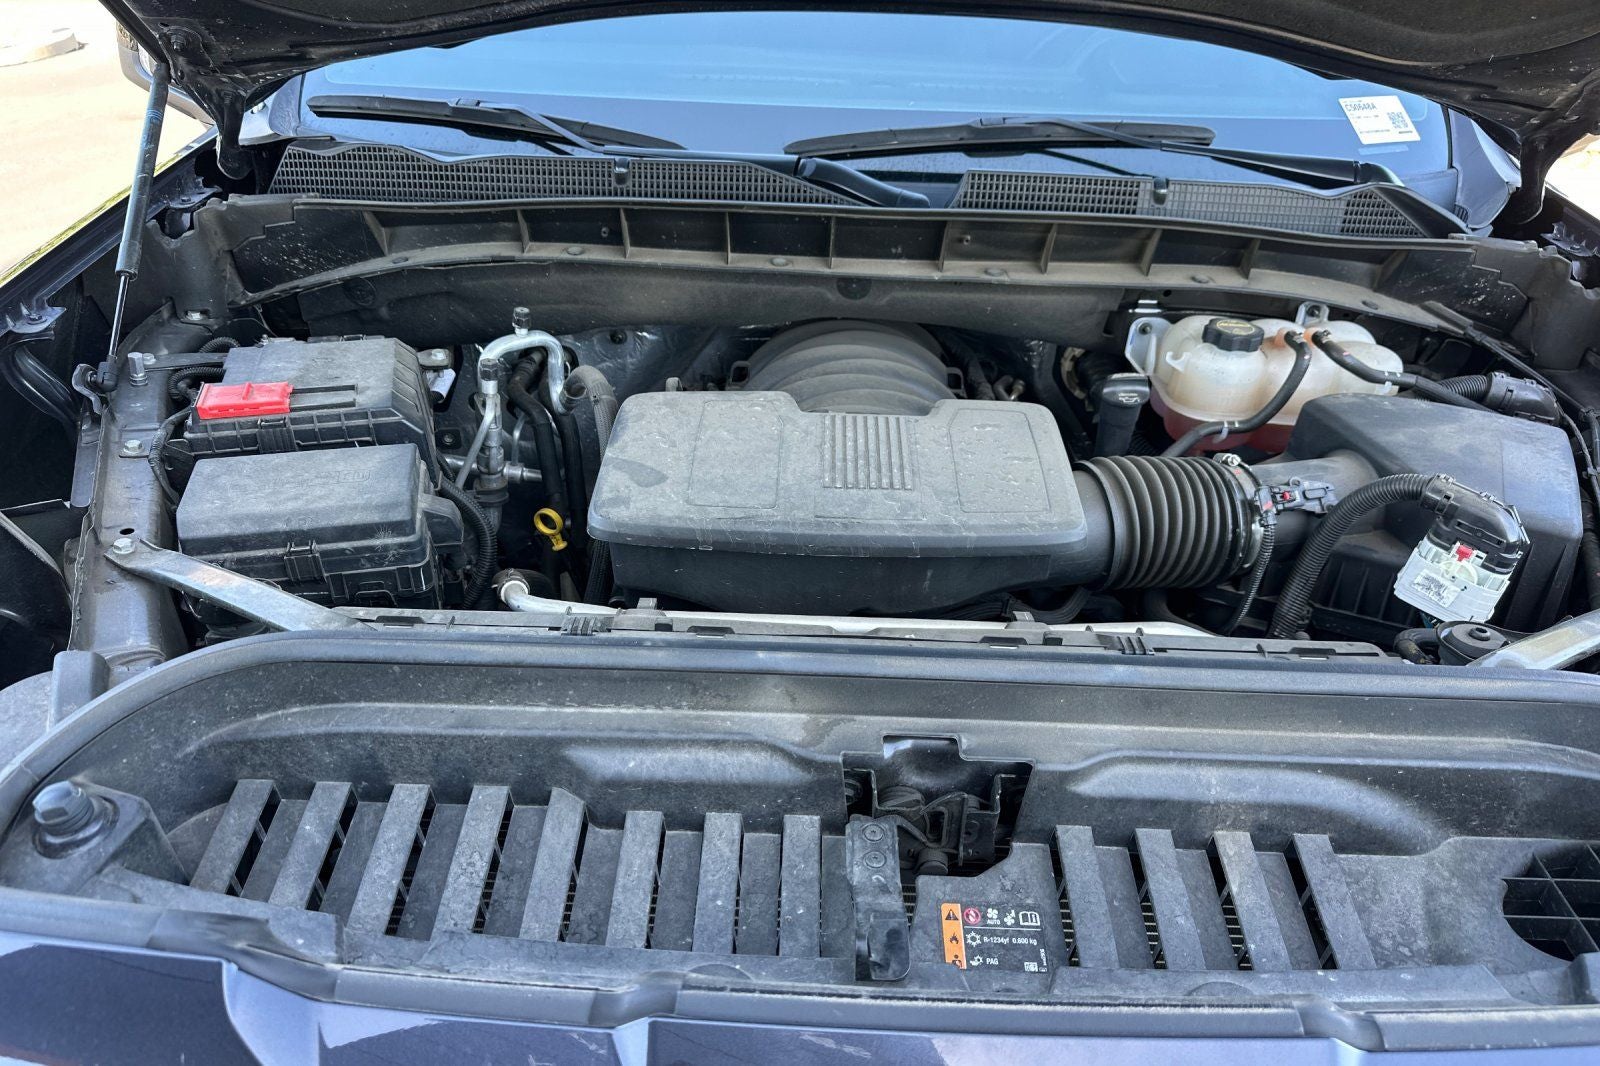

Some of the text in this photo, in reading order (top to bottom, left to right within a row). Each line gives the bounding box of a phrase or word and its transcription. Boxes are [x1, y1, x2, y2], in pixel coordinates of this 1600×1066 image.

[983, 936, 1010, 945] R-1234yf
[1029, 937, 1038, 946] kg
[986, 957, 999, 966] PAG
